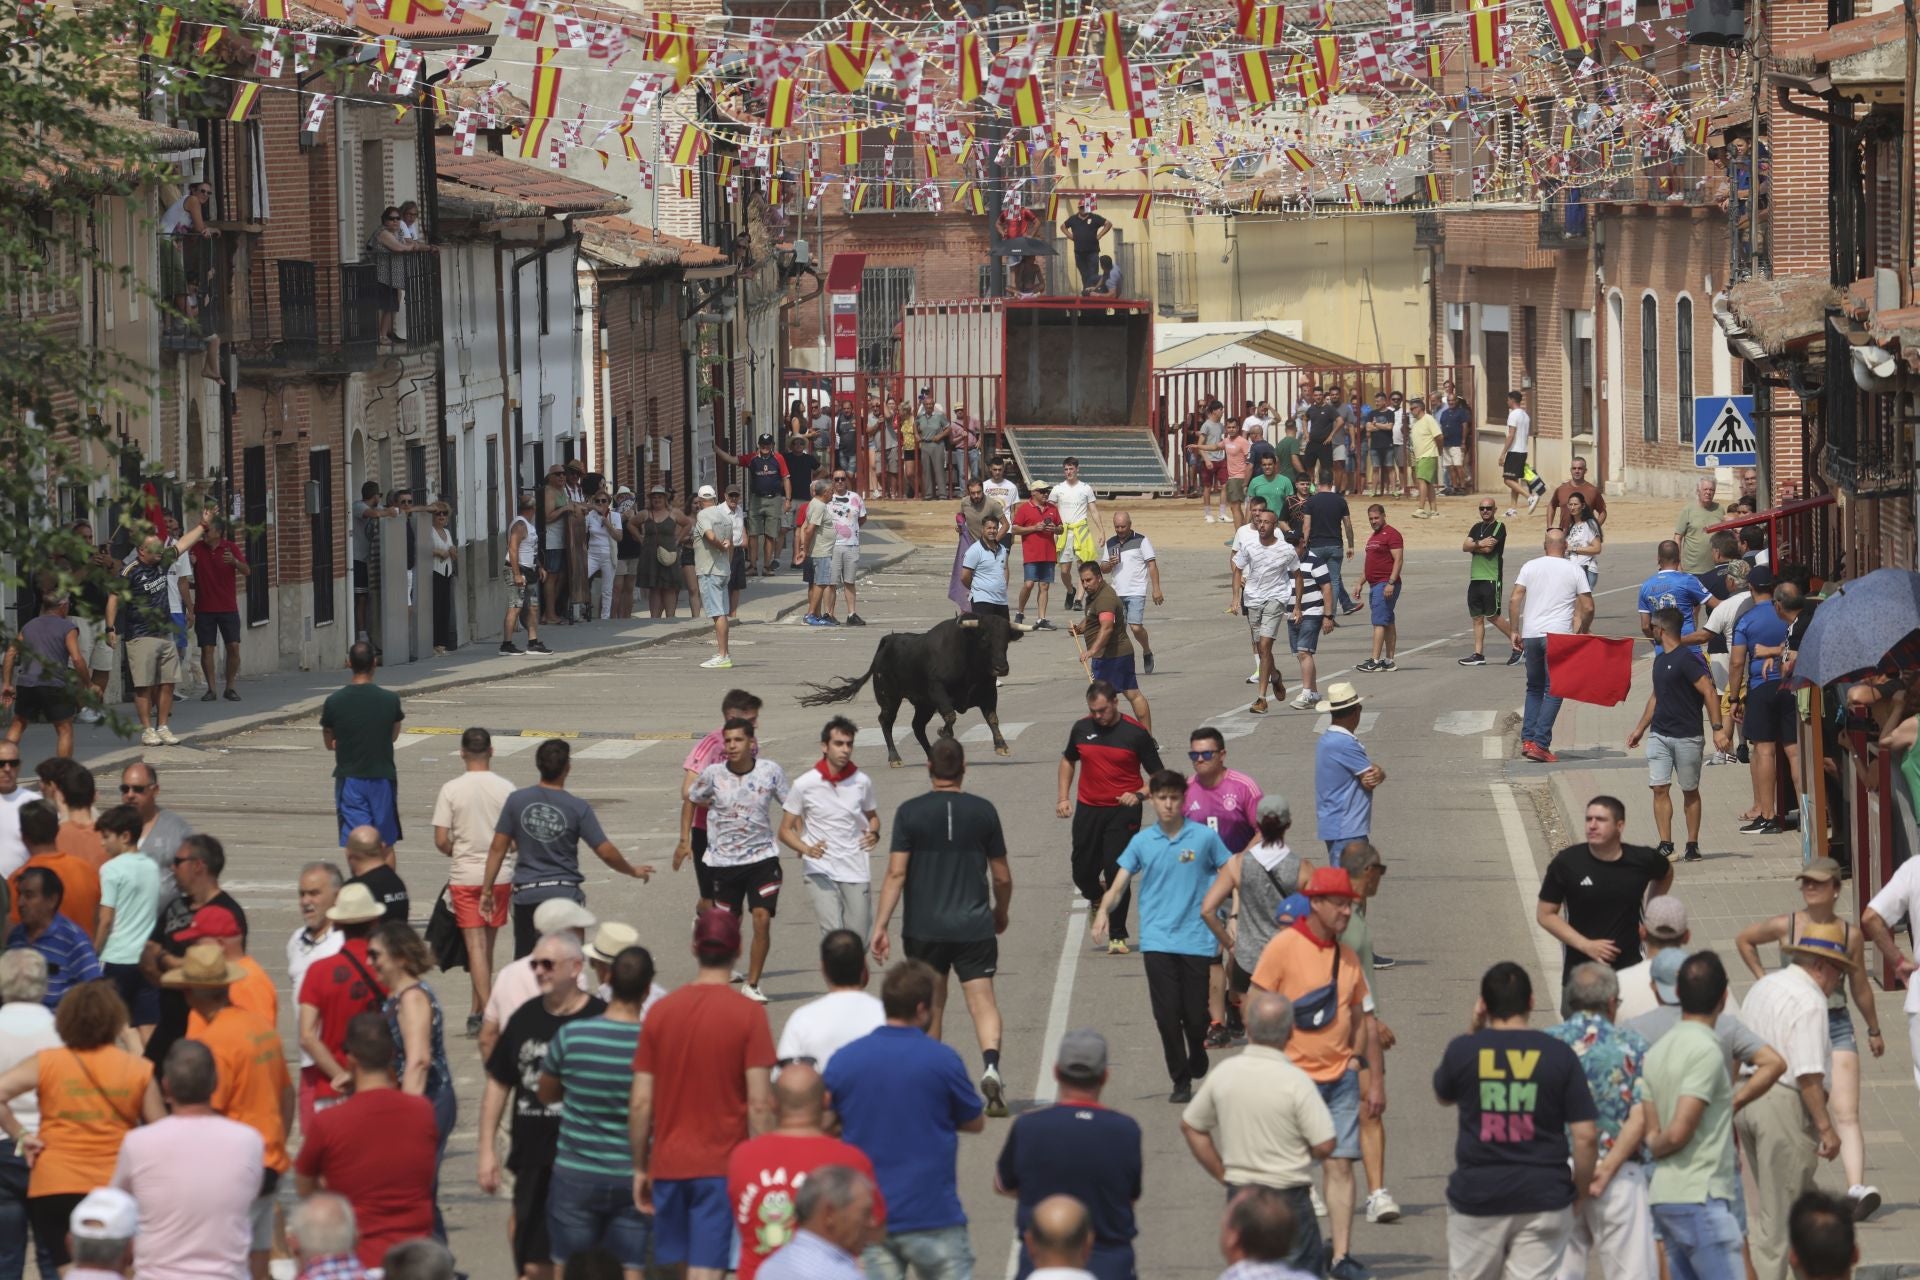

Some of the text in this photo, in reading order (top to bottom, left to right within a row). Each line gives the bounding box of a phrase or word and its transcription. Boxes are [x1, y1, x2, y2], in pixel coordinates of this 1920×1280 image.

[1478, 1048, 1541, 1080] LV
[1479, 1081, 1538, 1112] RM
[759, 1166, 788, 1188] LA
